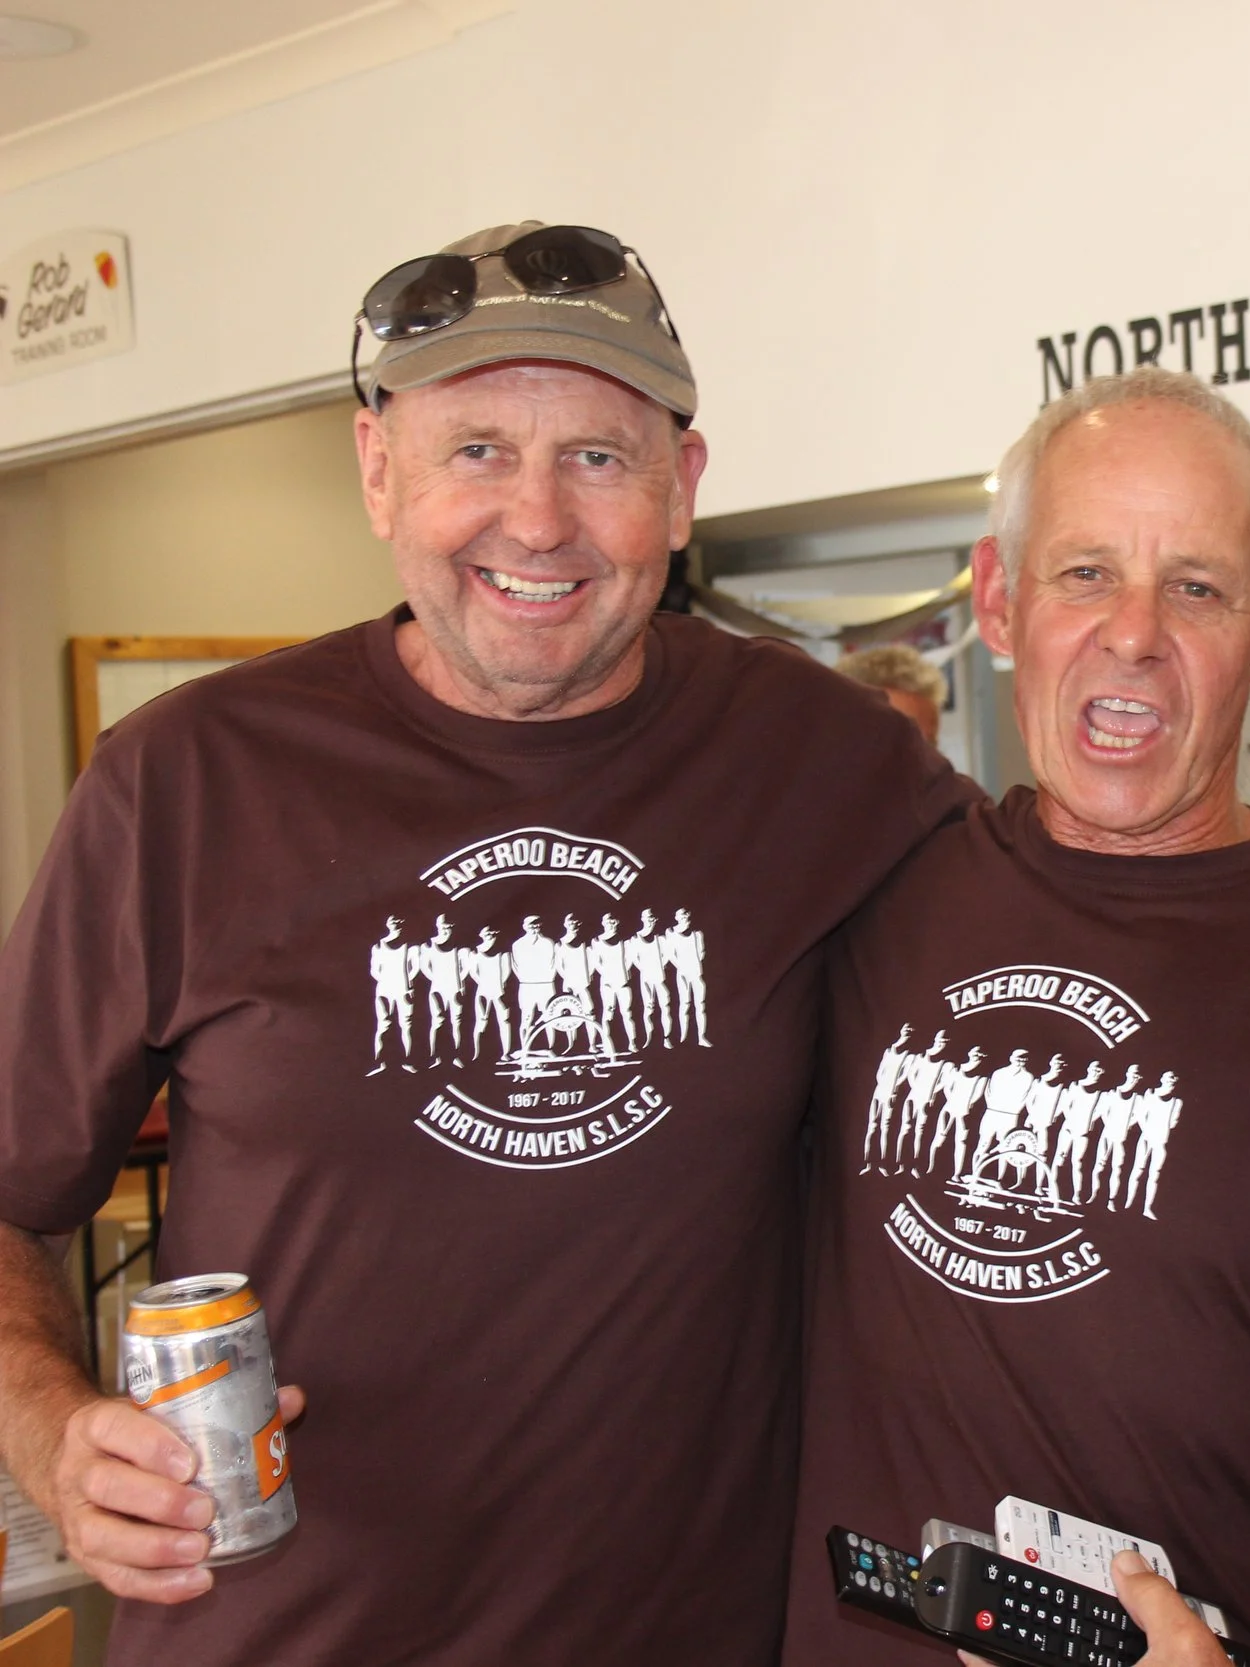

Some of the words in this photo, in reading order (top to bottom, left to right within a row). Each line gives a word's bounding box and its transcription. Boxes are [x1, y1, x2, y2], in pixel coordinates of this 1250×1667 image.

[27, 251, 70, 300] Rob
[427, 838, 546, 895] TAPEROO
[550, 842, 639, 894] BEACH
[945, 974, 1061, 1013] TAPEROO
[1058, 980, 1141, 1044] BEACH
[507, 1093, 540, 1108] 1967
[551, 1090, 586, 1106] 2017
[422, 1094, 503, 1151] NORTH
[504, 1126, 587, 1157] HAVEN
[588, 1085, 663, 1146] S.L.S.C
[953, 1217, 984, 1235] 1967
[993, 1225, 1027, 1243] 2017
[889, 1202, 948, 1268] NORTH
[945, 1252, 1022, 1290] HAVEN
[1026, 1241, 1101, 1289] S.L.S.C
[1008, 1575, 1017, 1584] 3
[1024, 1580, 1033, 1589] 6
[1040, 1586, 1049, 1595] 9
[1005, 1598, 1014, 1608] 2
[1021, 1604, 1030, 1613] 5
[1037, 1609, 1046, 1619] 8
[1053, 1616, 1062, 1625] 0
[1002, 1622, 1011, 1630] 1
[1018, 1628, 1028, 1638] 4
[1034, 1633, 1043, 1643] 7
